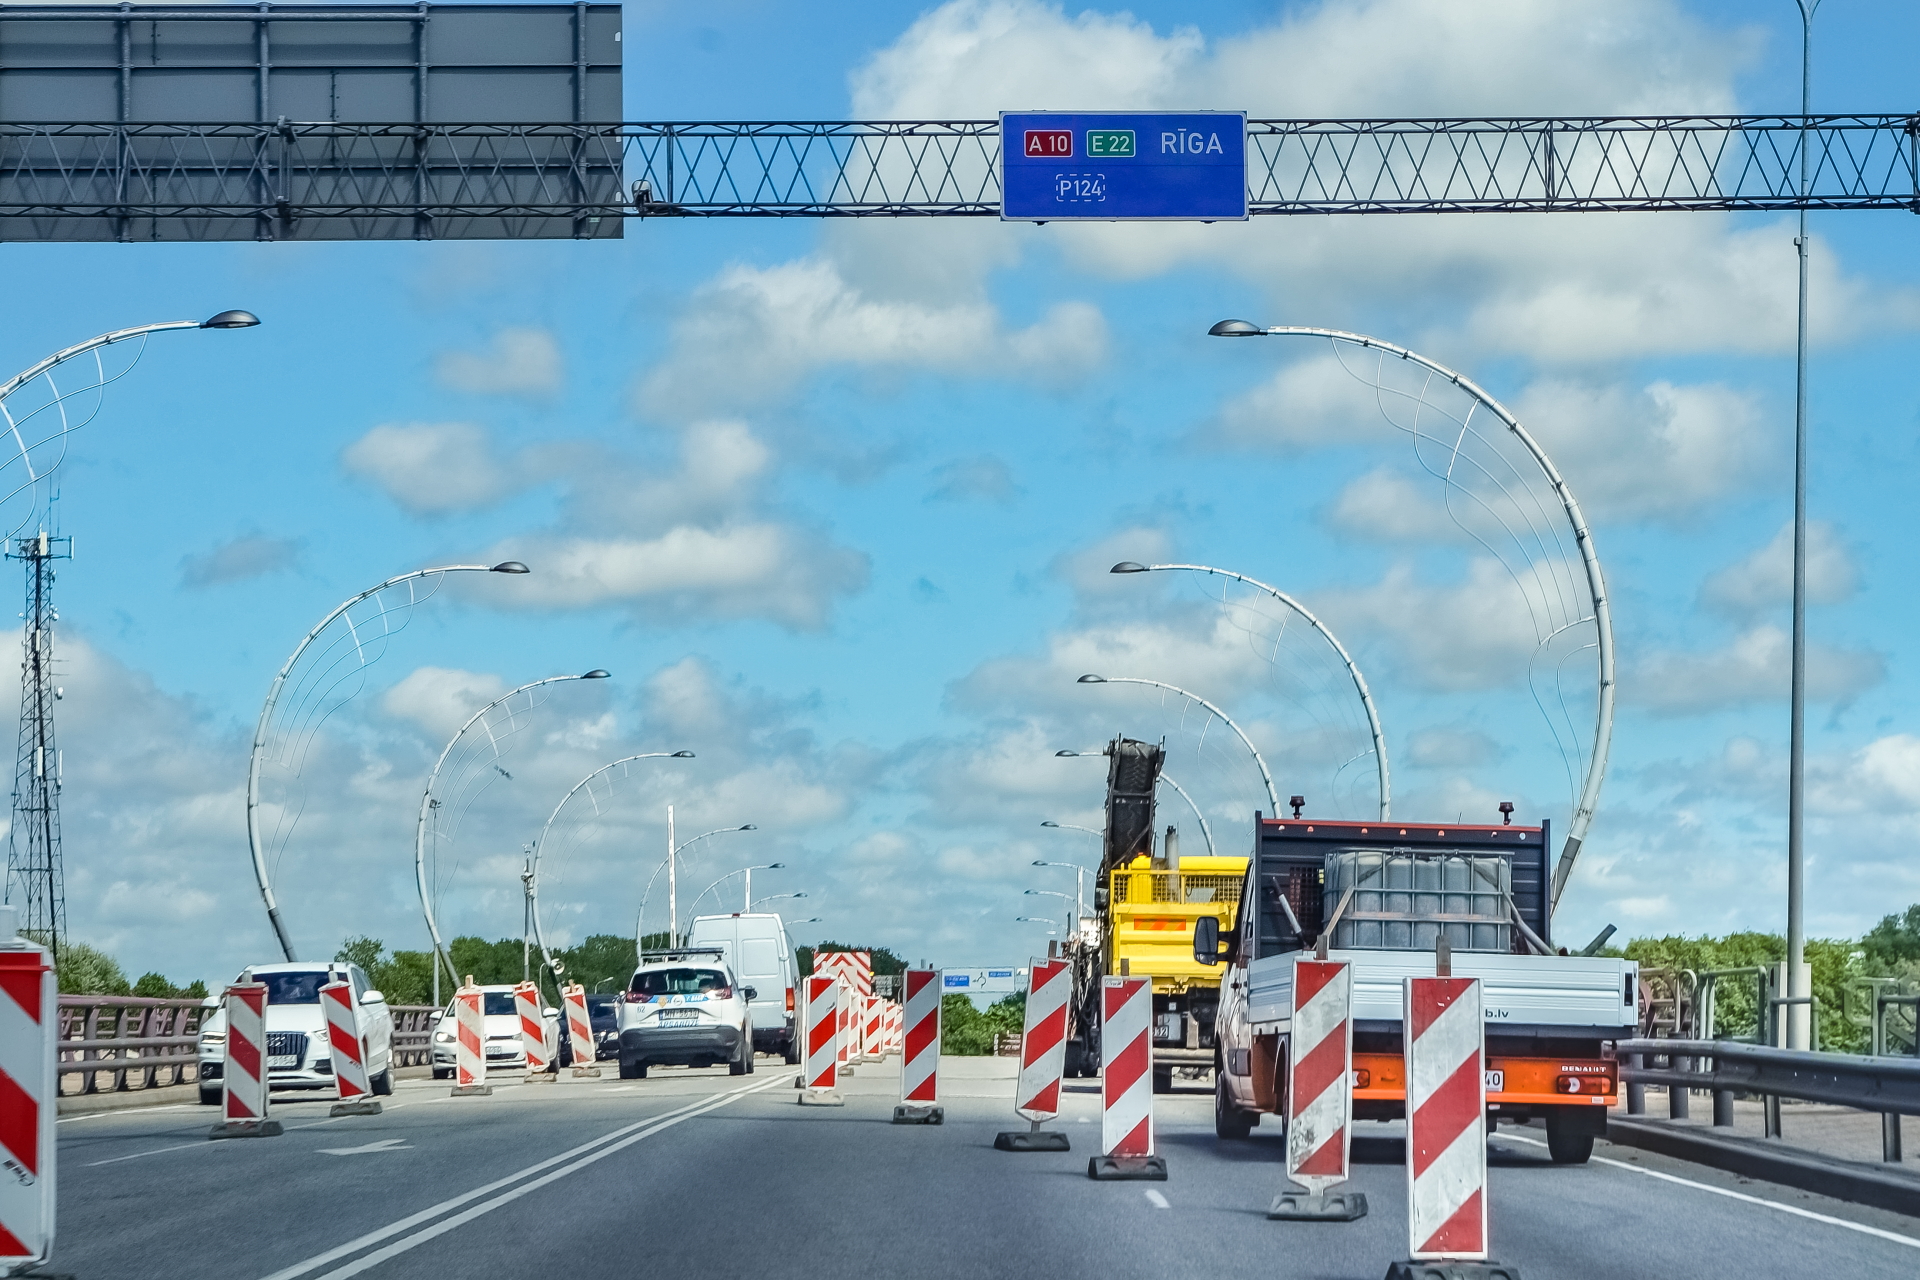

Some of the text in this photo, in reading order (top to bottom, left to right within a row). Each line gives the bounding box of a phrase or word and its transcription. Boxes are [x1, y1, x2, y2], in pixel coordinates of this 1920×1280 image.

[1028, 135, 1068, 152] A 10
[1092, 135, 1130, 152] E 22
[1161, 128, 1224, 154] RĪGA
[1060, 180, 1102, 197] P124
